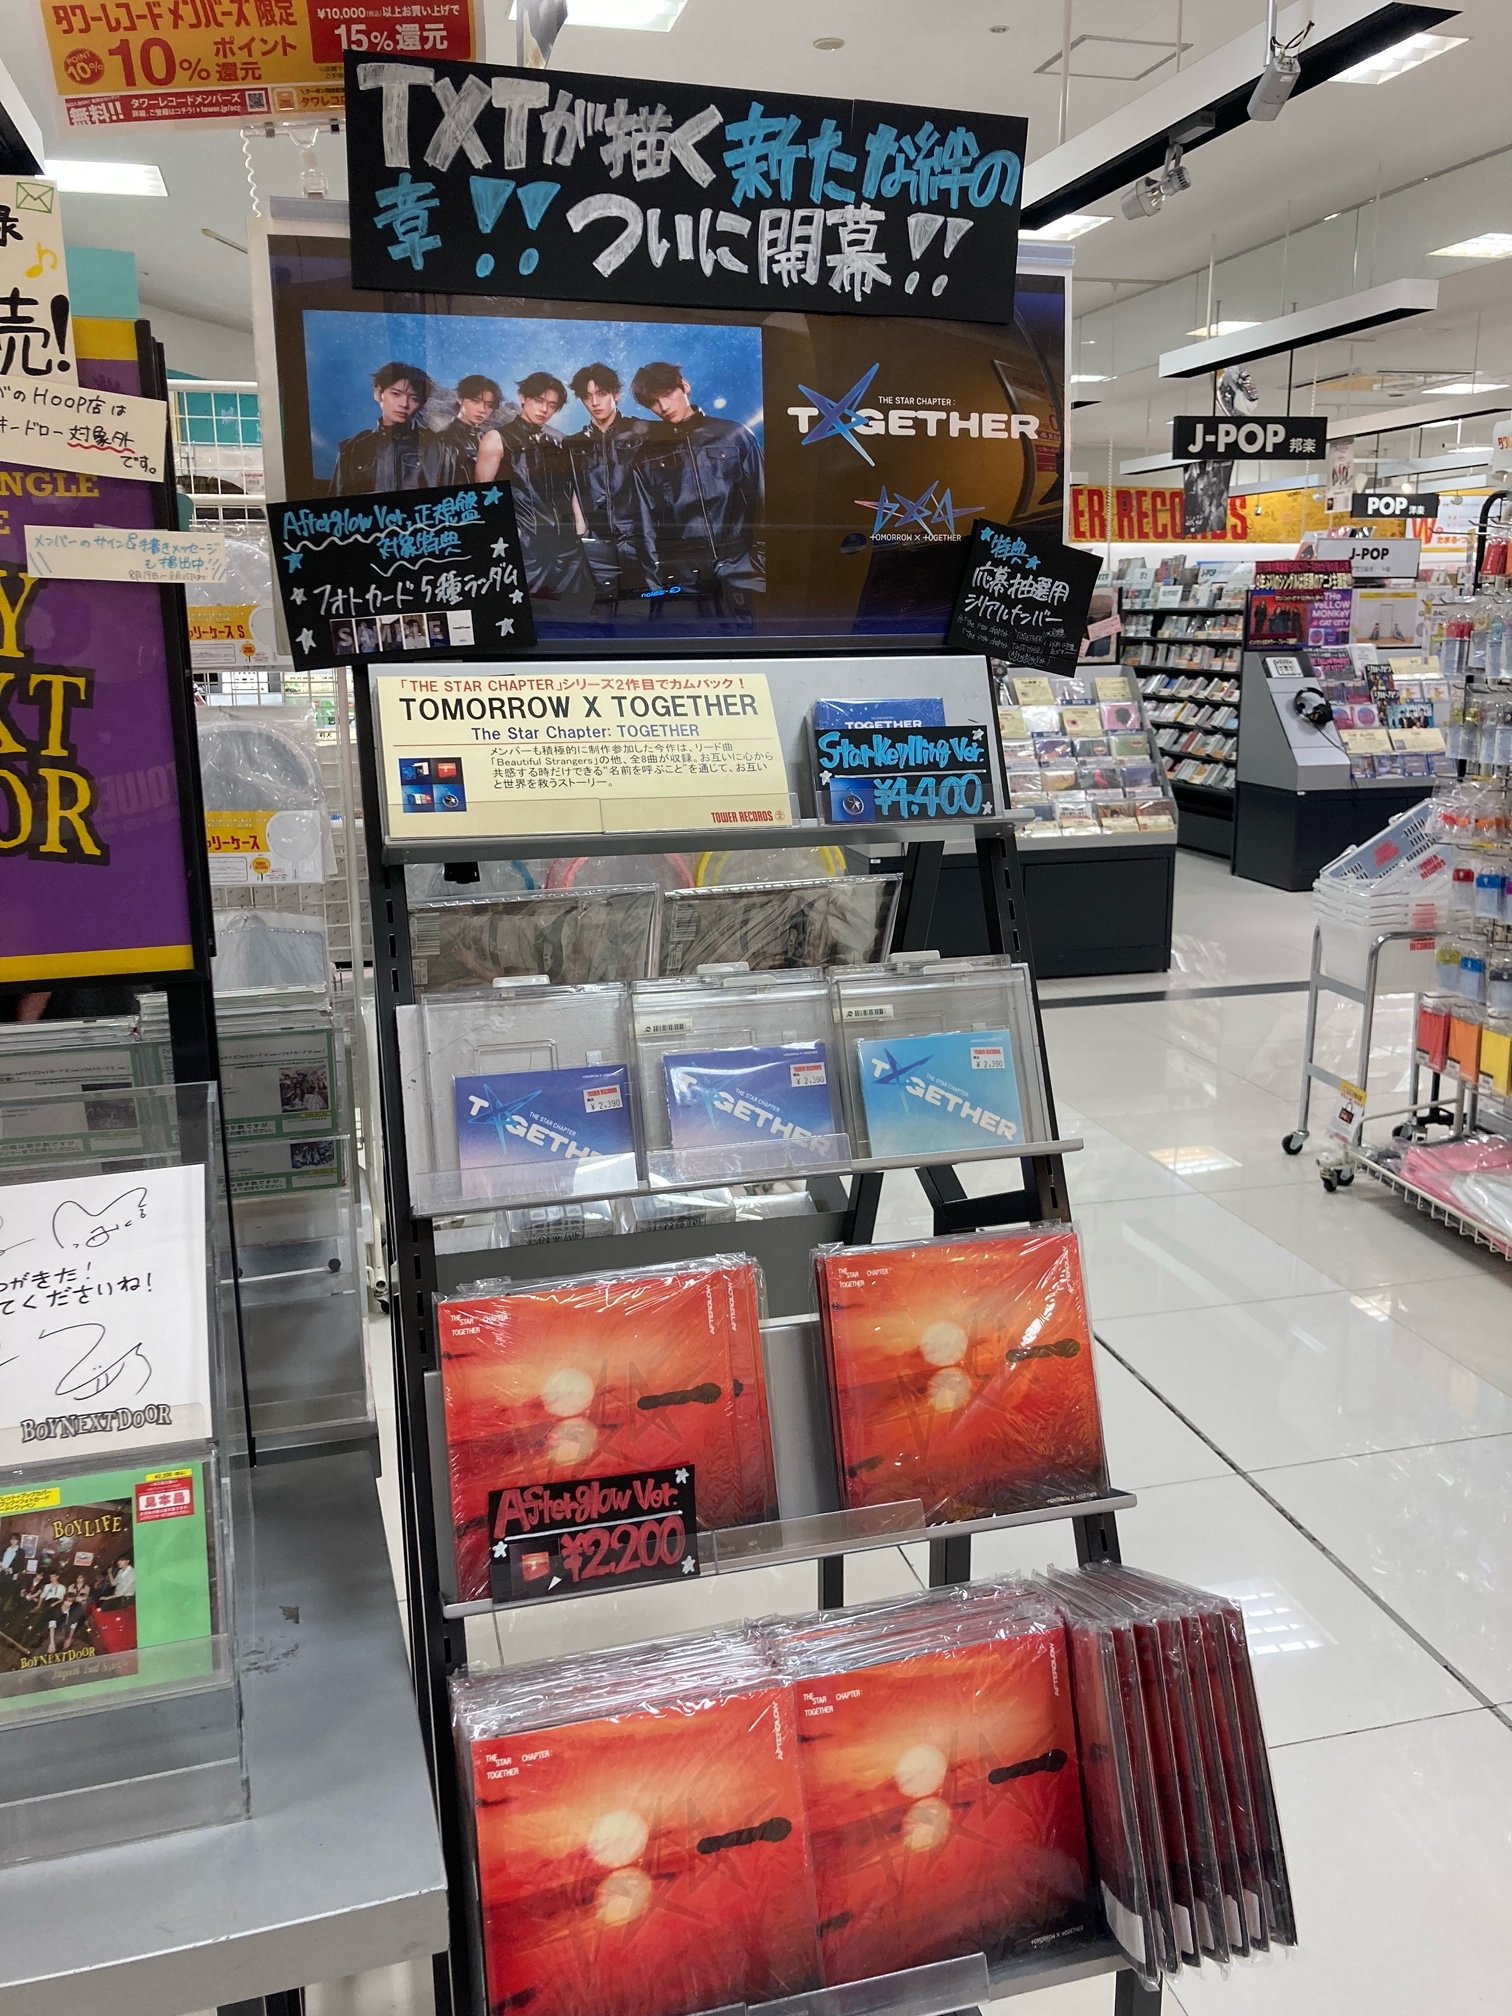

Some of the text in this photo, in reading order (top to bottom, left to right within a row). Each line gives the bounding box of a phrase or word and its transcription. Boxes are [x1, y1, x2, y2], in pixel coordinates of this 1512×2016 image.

[213, 35, 297, 59] ポイント
[66, 51, 92, 66] POINT
[108, 37, 211, 87] 10%
[67, 61, 104, 83] 10%
[215, 61, 262, 82] 還元
[131, 92, 241, 109] タワーレコードメンバーズ
[69, 100, 125, 126] 無料!!
[564, 191, 975, 304] ついに開幕!!
[878, 395, 893, 405] THE
[895, 396, 915, 406] STAR
[1187, 423, 1316, 454] J-POP 邦楽
[120, 454, 157, 475] です。
[1115, 489, 1248, 540] RECOS
[1367, 496, 1408, 516] POP
[922, 533, 962, 542] TOGETHER
[1349, 547, 1390, 560] J-POP
[237, 624, 245, 639] S
[443, 679, 482, 692] STAR
[398, 693, 759, 721] TOMORROW X TOGETHER
[471, 723, 700, 742] The Star Chapter: TOGETHER
[844, 719, 923, 730] TOGETHER
[951, 736, 985, 764] Ver.
[493, 777, 613, 790] と世界を救うストーリー。
[873, 772, 984, 820] ¥4,400
[711, 809, 774, 824] TOWER RECORDS
[1419, 853, 1440, 870] TOWER
[1420, 858, 1447, 880] RECORDS
[926, 1073, 970, 1098] THE STAR CHAPTER
[735, 1087, 781, 1113] THE STAR CHAPTER
[529, 1111, 577, 1137] THE STAR CHAPTER
[838, 1267, 848, 1276] THE
[846, 1271, 859, 1280] STAR
[838, 1279, 865, 1289] TOGETHER
[451, 1314, 462, 1323] THE
[450, 1326, 481, 1337] TOGETHER
[144, 1491, 186, 1508] 見本品
[632, 1478, 680, 1511] Ver.
[1048, 1642, 1060, 1697] AFTERGLOW
[803, 1691, 815, 1702] THE
[811, 1696, 828, 1706] STAR
[803, 1705, 834, 1718] TOGETHER
[772, 1700, 784, 1761] AFTERGLOW
[484, 1753, 498, 1763] THE
[495, 1757, 513, 1768] STAR
[485, 1766, 520, 1781] TOGETHER
